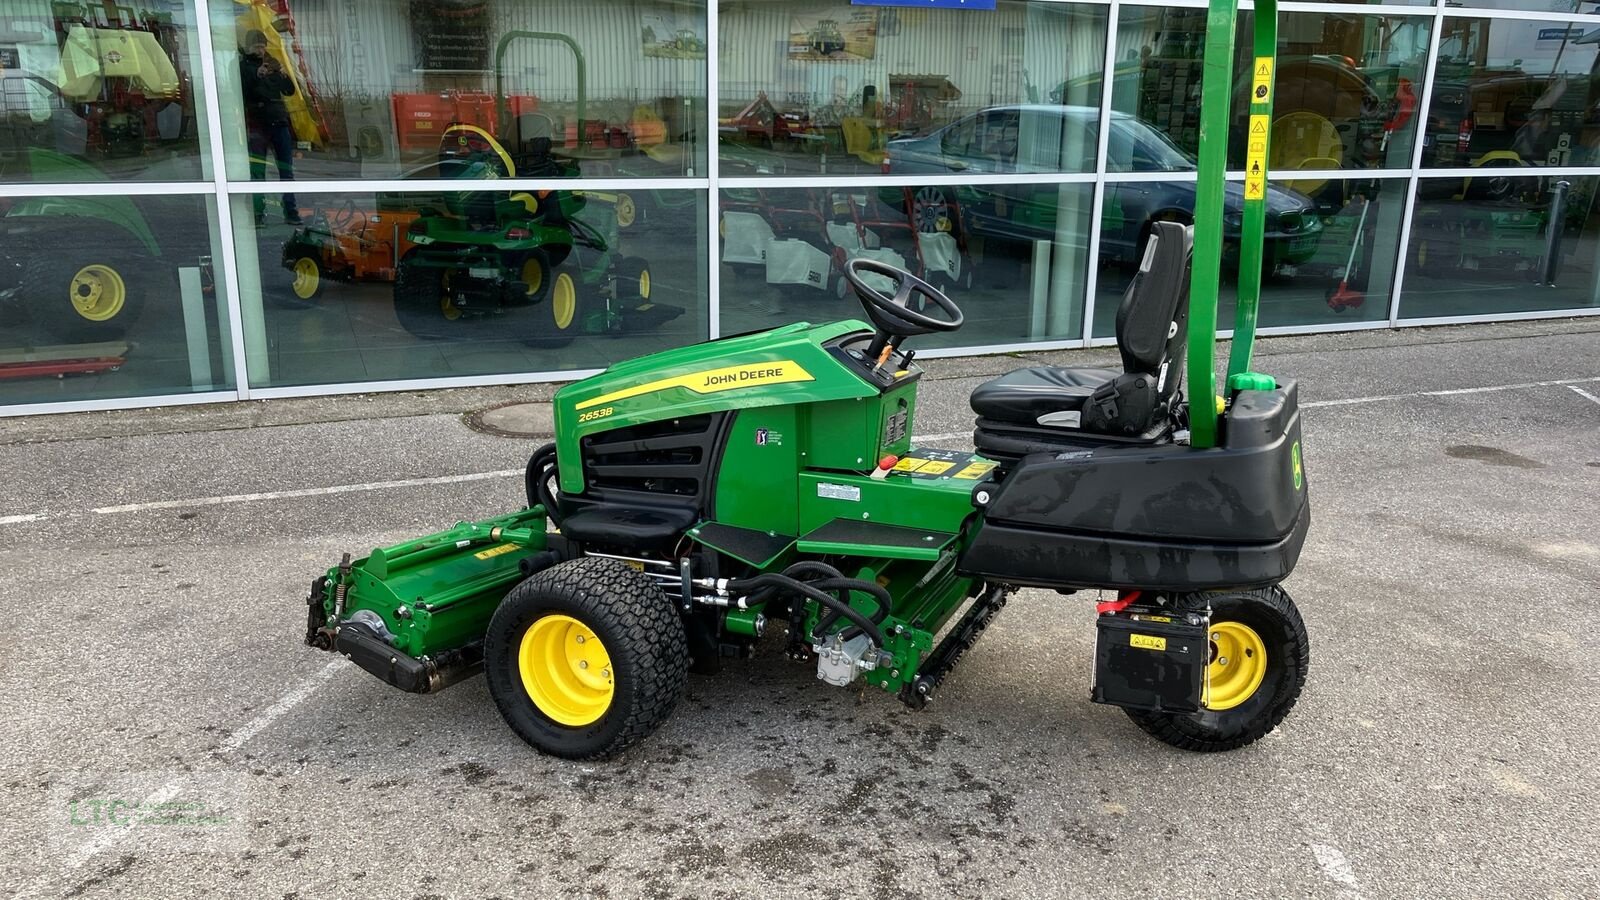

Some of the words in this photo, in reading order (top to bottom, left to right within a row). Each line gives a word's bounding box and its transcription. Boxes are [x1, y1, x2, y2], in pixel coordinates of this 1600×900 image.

[704, 373, 737, 386] JOHN
[740, 368, 783, 381] DEERE
[578, 407, 614, 423] 2653B
